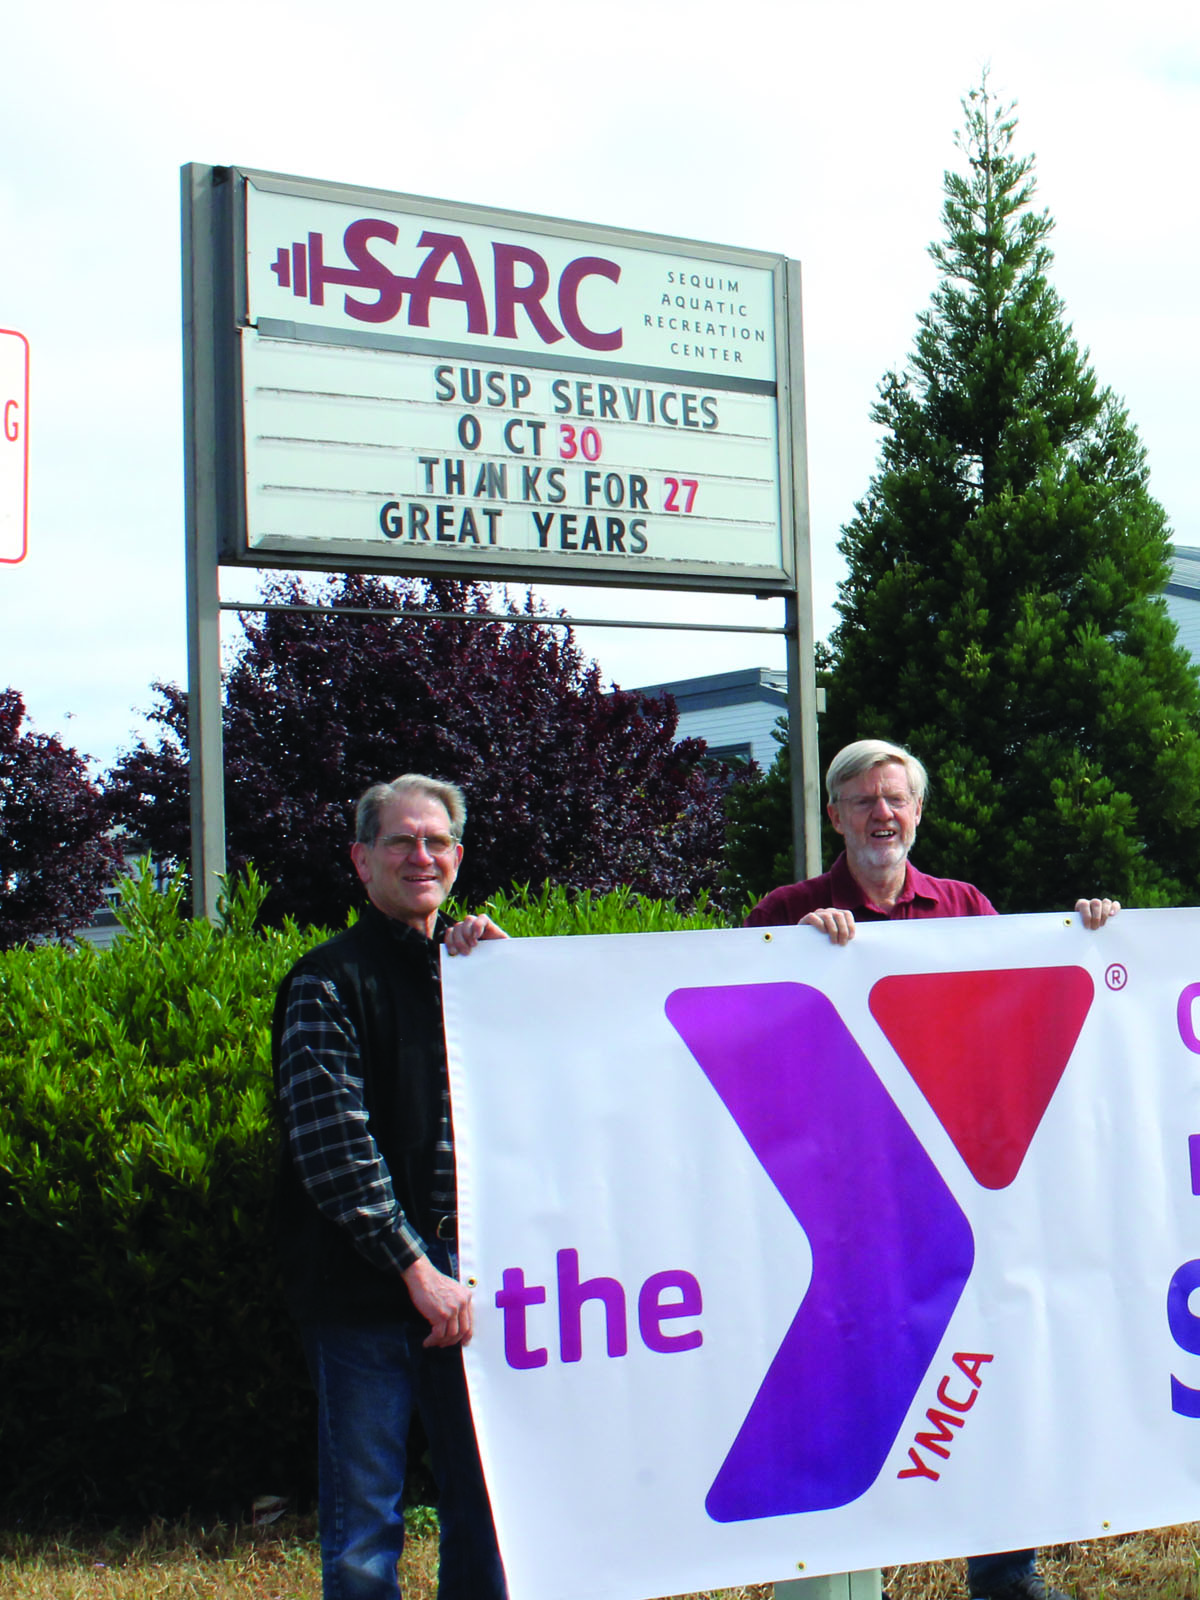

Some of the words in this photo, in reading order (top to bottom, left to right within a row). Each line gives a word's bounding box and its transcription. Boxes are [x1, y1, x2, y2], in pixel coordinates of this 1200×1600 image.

[343, 218, 623, 352] SARC
[661, 293, 747, 317] AQUATIC
[667, 271, 739, 292] SEQUIM
[644, 314, 765, 342] RECREATION
[670, 342, 743, 363] CENTER
[434, 365, 531, 408] SUSP
[552, 379, 719, 429] SERVICES
[559, 424, 602, 461] 30
[418, 456, 566, 503] THANKS
[584, 470, 649, 510] FOR
[663, 477, 699, 513] 27
[379, 501, 502, 545] GREAT
[533, 512, 648, 554] YEARS
[494, 1248, 703, 1370] the
[897, 1352, 994, 1482] YMCA
